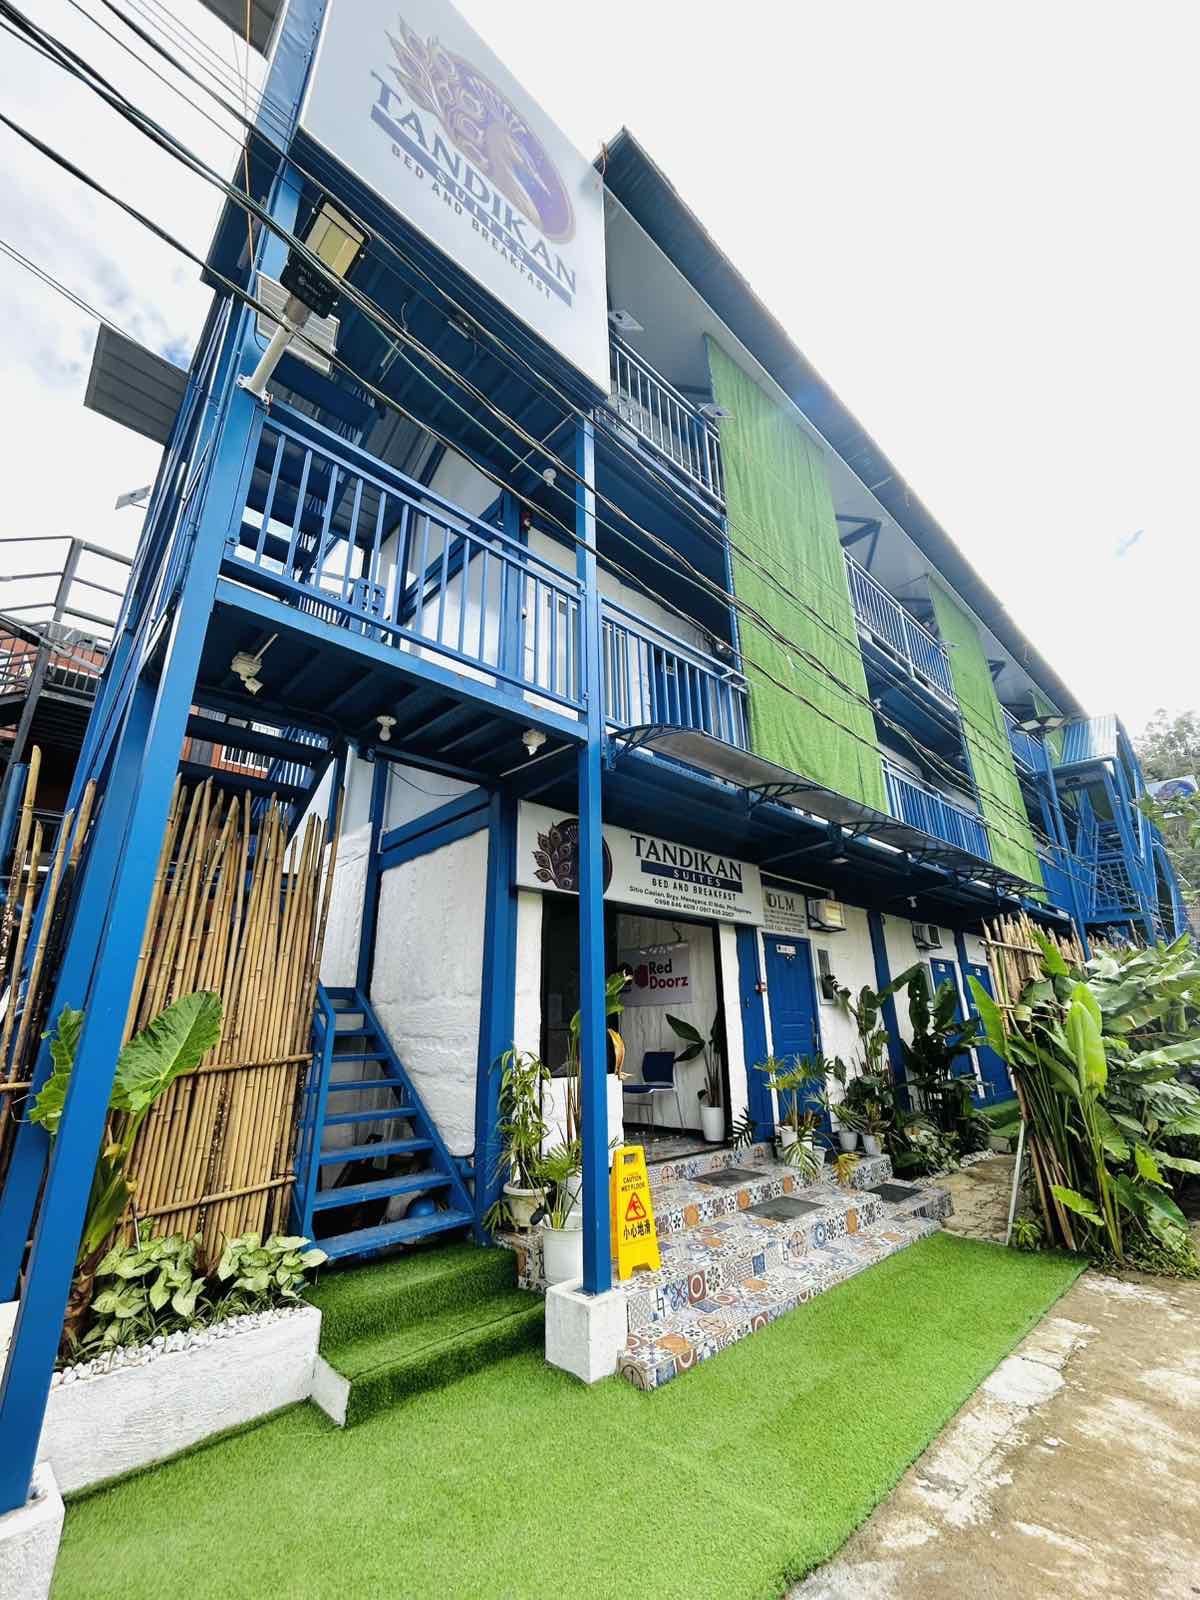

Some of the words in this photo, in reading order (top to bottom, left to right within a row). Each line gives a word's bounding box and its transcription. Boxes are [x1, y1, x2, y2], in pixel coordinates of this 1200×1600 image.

[370, 70, 576, 296] TANDIKAN
[391, 143, 424, 179] BED
[431, 181, 463, 216] AND
[472, 217, 552, 299] BREAKFAST
[436, 168, 525, 260] SUITES
[630, 834, 742, 881] TANDIKAN
[673, 868, 721, 887] SUITES
[652, 878, 669, 889] BED
[673, 881, 689, 892] AND
[693, 884, 736, 901] BREAKFAST
[768, 892, 795, 912] DLM
[648, 958, 672, 975] Red
[649, 975, 688, 989] Doorz
[623, 1175, 642, 1184] CAUTION
[623, 1219, 650, 1241] 小心地滑
